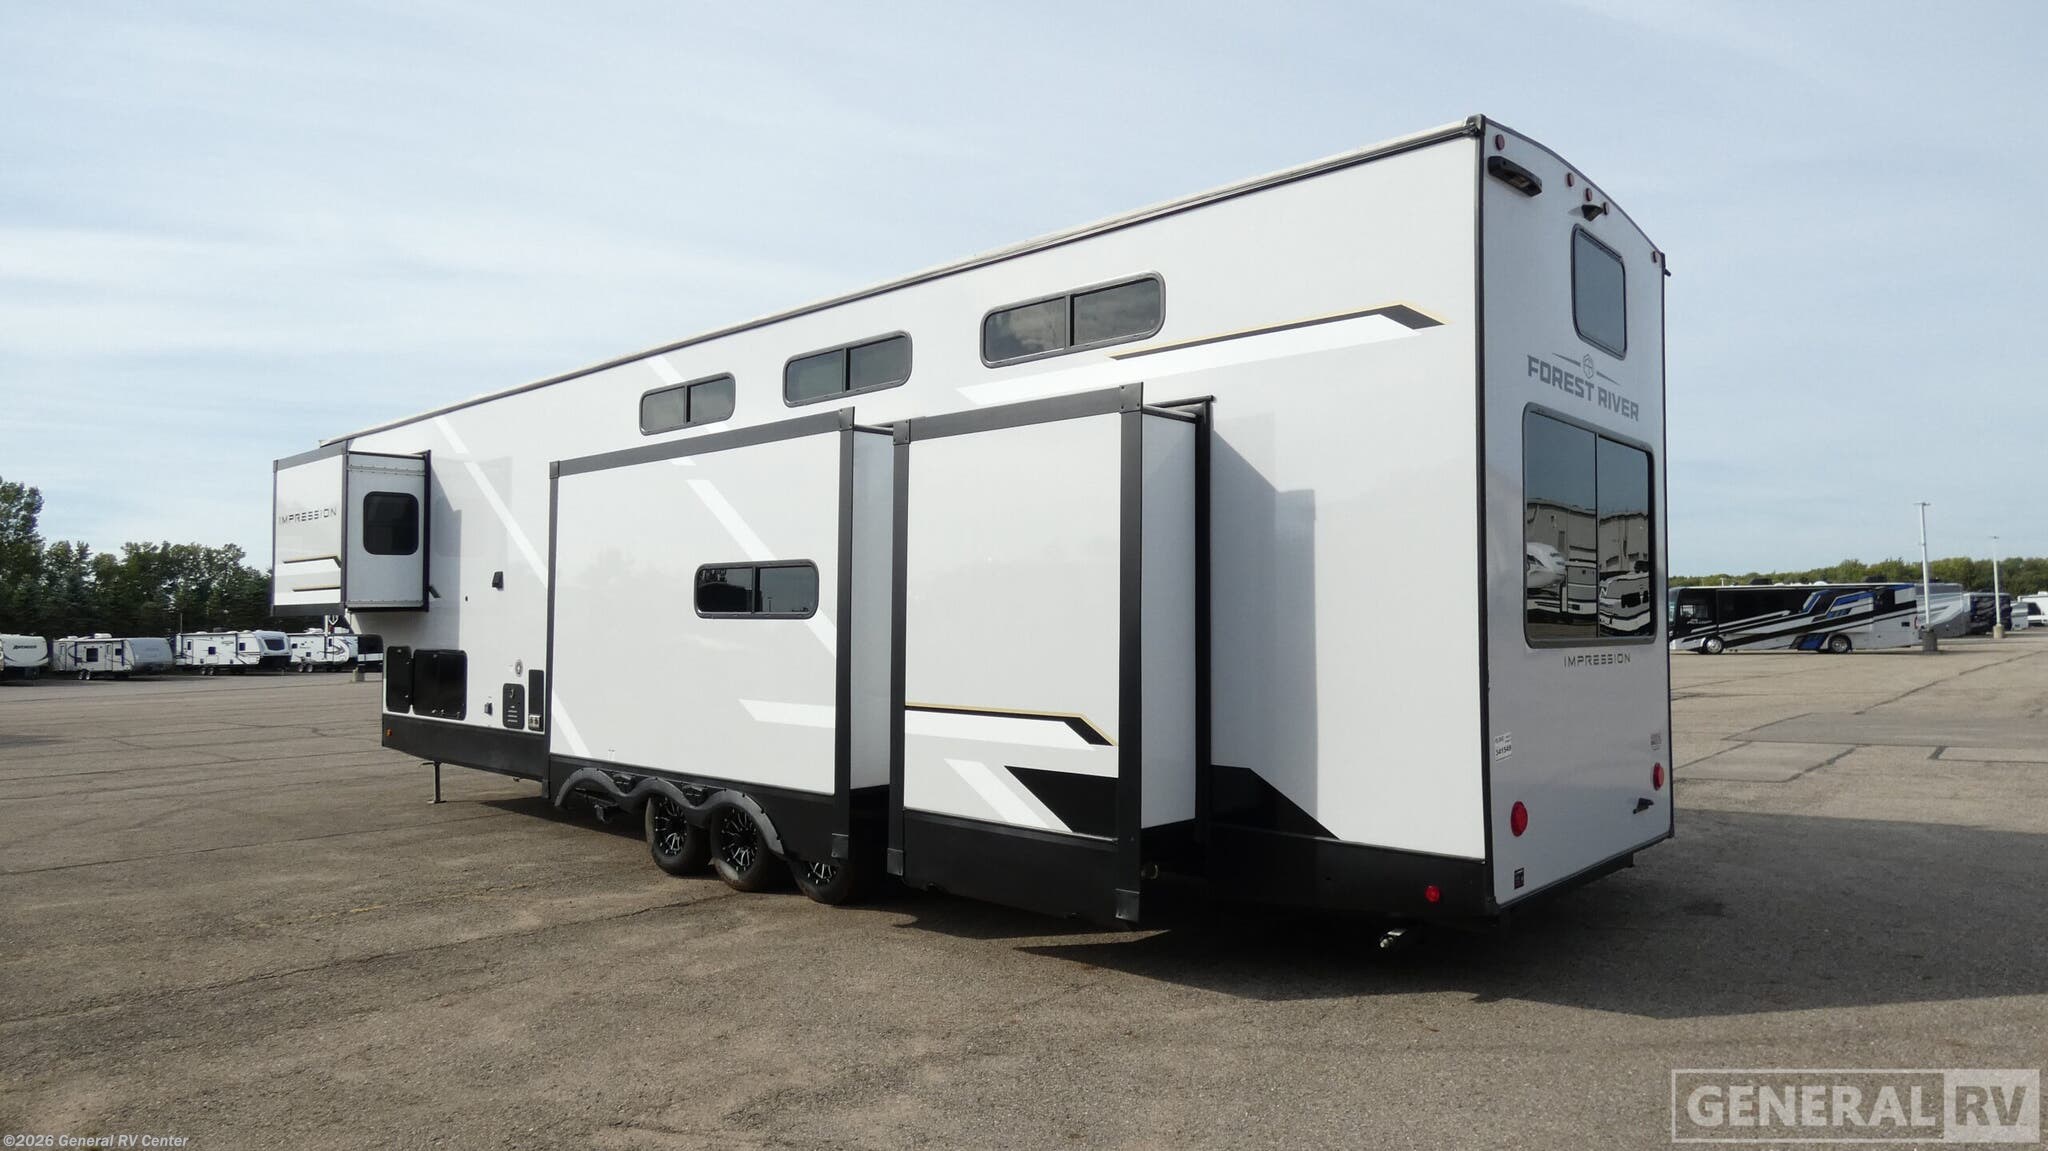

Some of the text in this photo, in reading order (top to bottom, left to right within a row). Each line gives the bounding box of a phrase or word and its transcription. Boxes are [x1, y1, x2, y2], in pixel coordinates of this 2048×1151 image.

[1527, 354, 1640, 422] FOREST RIVER
[278, 508, 337, 525] IMPRESSION
[1563, 653, 1631, 668] IMPRESSION
